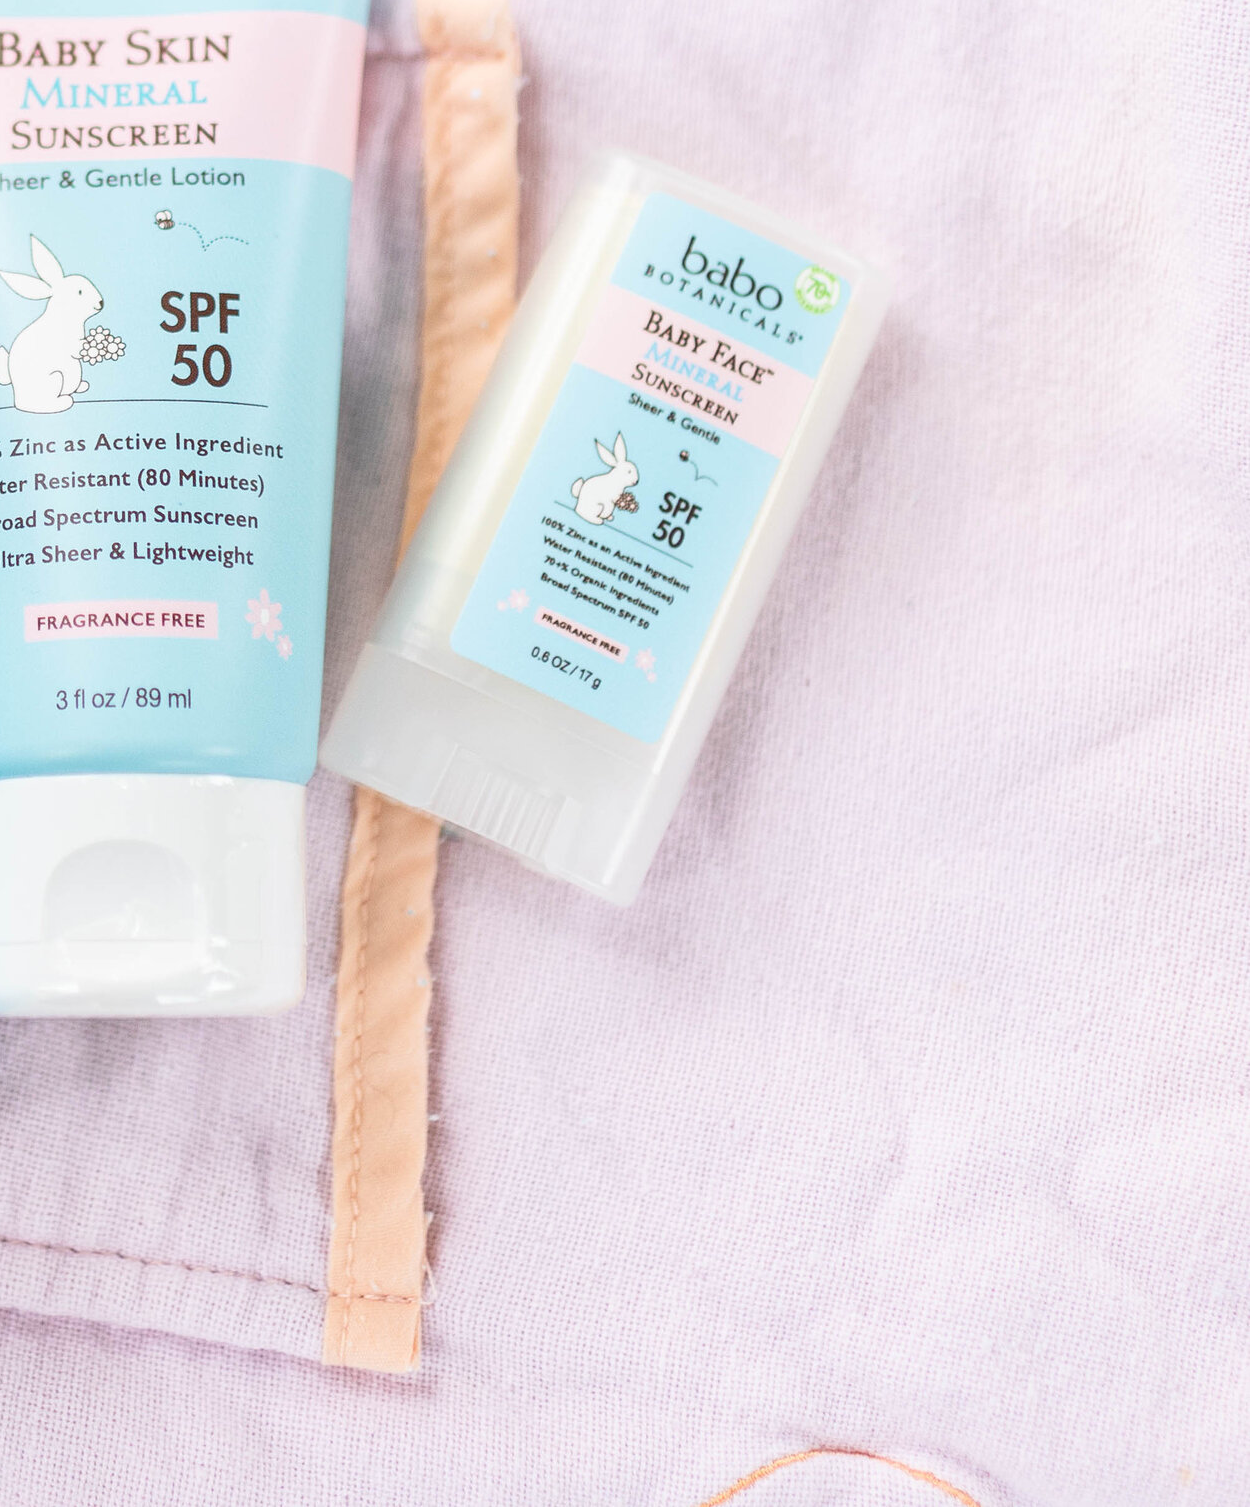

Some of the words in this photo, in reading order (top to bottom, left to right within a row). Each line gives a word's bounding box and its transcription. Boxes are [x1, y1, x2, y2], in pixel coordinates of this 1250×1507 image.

[126, 31, 232, 65] SKIN
[19, 78, 207, 110] MINERAL
[12, 122, 218, 150] SUNSCREEN
[60, 171, 74, 189] &
[86, 169, 162, 189] Gentle
[171, 167, 245, 186] Lotion
[682, 236, 783, 311] babo
[160, 292, 240, 334] SPF
[644, 310, 706, 354] BABY
[171, 344, 232, 387] 50
[644, 342, 743, 402] MINERAL
[632, 363, 739, 425] SUNSCREEN
[628, 393, 664, 416] Sheer
[667, 412, 676, 423] &
[681, 417, 720, 444] Gentle
[10, 438, 56, 457] Zinc
[64, 437, 86, 452] as
[94, 433, 166, 451] Active
[176, 433, 284, 460] Ingredient
[34, 470, 130, 491] Resistant
[138, 470, 171, 492] (80
[179, 471, 264, 497] Minutes)
[44, 506, 146, 531] Spectrum
[154, 506, 259, 529] Sunscreen
[658, 491, 702, 525] SPF
[42, 544, 103, 564] Sheer
[110, 543, 125, 561] &
[133, 542, 254, 568] Lightweight
[541, 516, 564, 531] 100%
[566, 527, 585, 541] Zinc
[588, 538, 597, 547] as
[600, 543, 611, 553] an
[613, 550, 641, 568] Active
[645, 564, 690, 592] Ingredient
[653, 519, 685, 549] 50
[543, 535, 572, 553] Water
[574, 550, 616, 575] Resistant
[618, 570, 634, 582] (80
[636, 579, 674, 604] Minutes)
[540, 572, 569, 591] Broad
[571, 586, 615, 614] Spectrum
[617, 609, 636, 622] SPF
[637, 618, 649, 629] 50
[571, 567, 606, 589] Organic
[609, 585, 658, 615] Ingredients
[37, 612, 155, 631] FRAGRANCE
[161, 613, 205, 628] FREE
[542, 613, 597, 644] FRAGRANCE
[599, 639, 620, 656] FREE
[531, 646, 549, 662] 0.6
[551, 655, 570, 673] OZ
[569, 665, 577, 675] /
[579, 667, 592, 681] 17
[592, 677, 601, 689] g
[56, 691, 68, 710] 3
[75, 688, 86, 708] fl
[91, 693, 116, 708] oz
[121, 688, 129, 709] /
[136, 688, 161, 708] 89
[168, 688, 191, 708] ml
